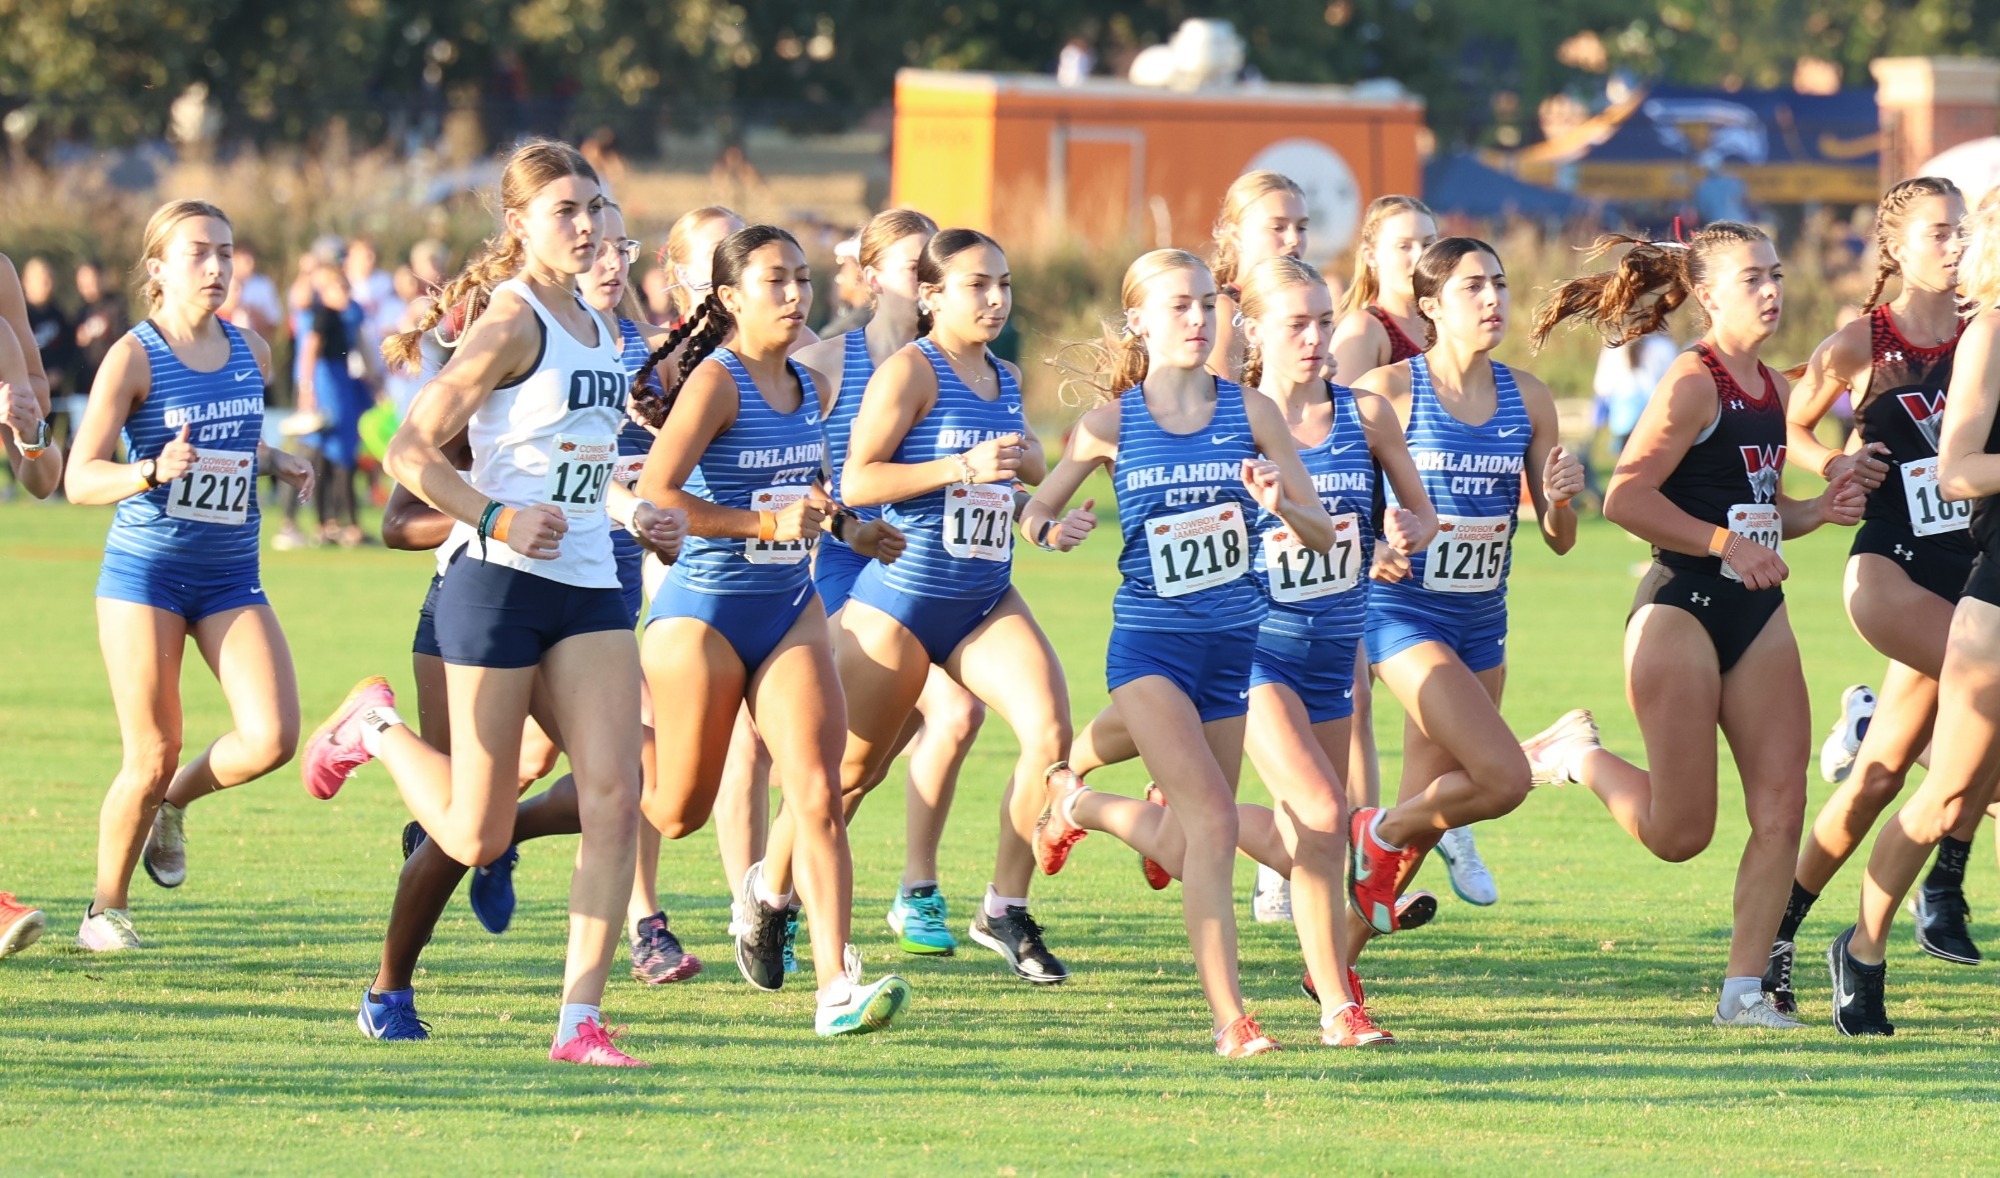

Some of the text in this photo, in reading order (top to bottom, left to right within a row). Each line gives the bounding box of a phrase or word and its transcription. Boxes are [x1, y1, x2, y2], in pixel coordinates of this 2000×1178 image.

[198, 420, 245, 442] CITY
[937, 429, 1025, 448] OKLA
[202, 457, 237, 466] COWBOY
[573, 452, 609, 462] JAMBOREE
[738, 443, 824, 469] OKLAHOM
[198, 465, 238, 475] JAMBOREE
[771, 466, 814, 485] CITY
[1126, 462, 1242, 492] OKLAHOM
[177, 472, 247, 512] 1212
[551, 462, 614, 504] 1297
[1311, 472, 1367, 493] HOMA
[1451, 476, 1498, 495] CITY
[966, 499, 1003, 508] JAMBOREE
[969, 490, 1002, 500] COWBOY
[1165, 485, 1221, 508] CITY
[953, 507, 1008, 548] 1213
[1171, 522, 1222, 541] JAMBOREE
[1173, 515, 1216, 531] COWBOY
[1457, 524, 1493, 533] COWBOY
[1452, 532, 1495, 541] JAMBOREE
[1160, 529, 1241, 584] 1218
[1277, 539, 1352, 590] 1217
[1434, 541, 1503, 580] 1215
